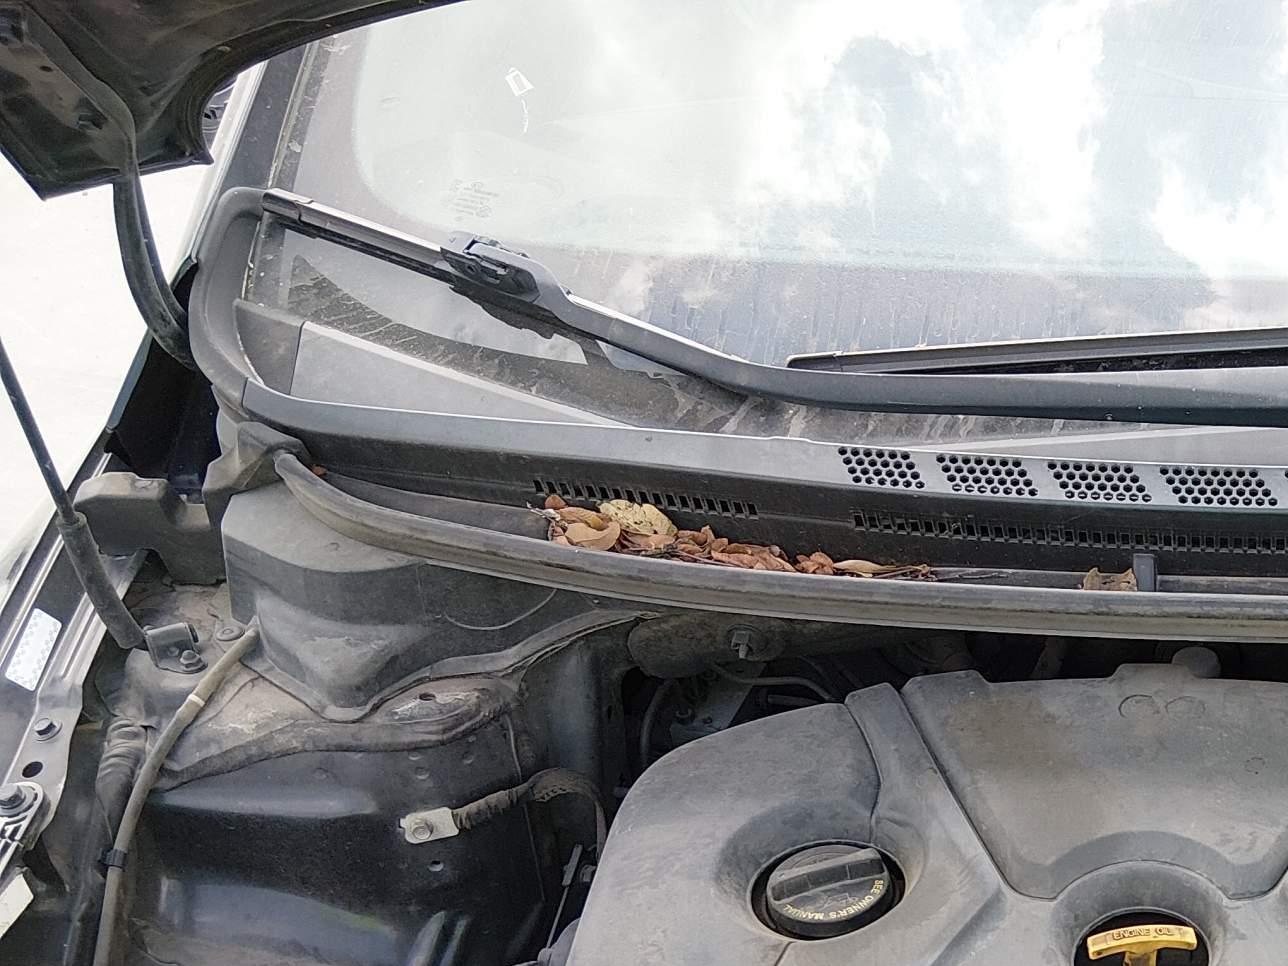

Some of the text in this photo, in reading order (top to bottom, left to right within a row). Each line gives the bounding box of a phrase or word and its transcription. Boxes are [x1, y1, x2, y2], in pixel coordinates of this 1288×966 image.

[783, 879, 884, 920] SEE OWNER'S MANUAL
[1112, 927, 1176, 940] ENGINE OIL
